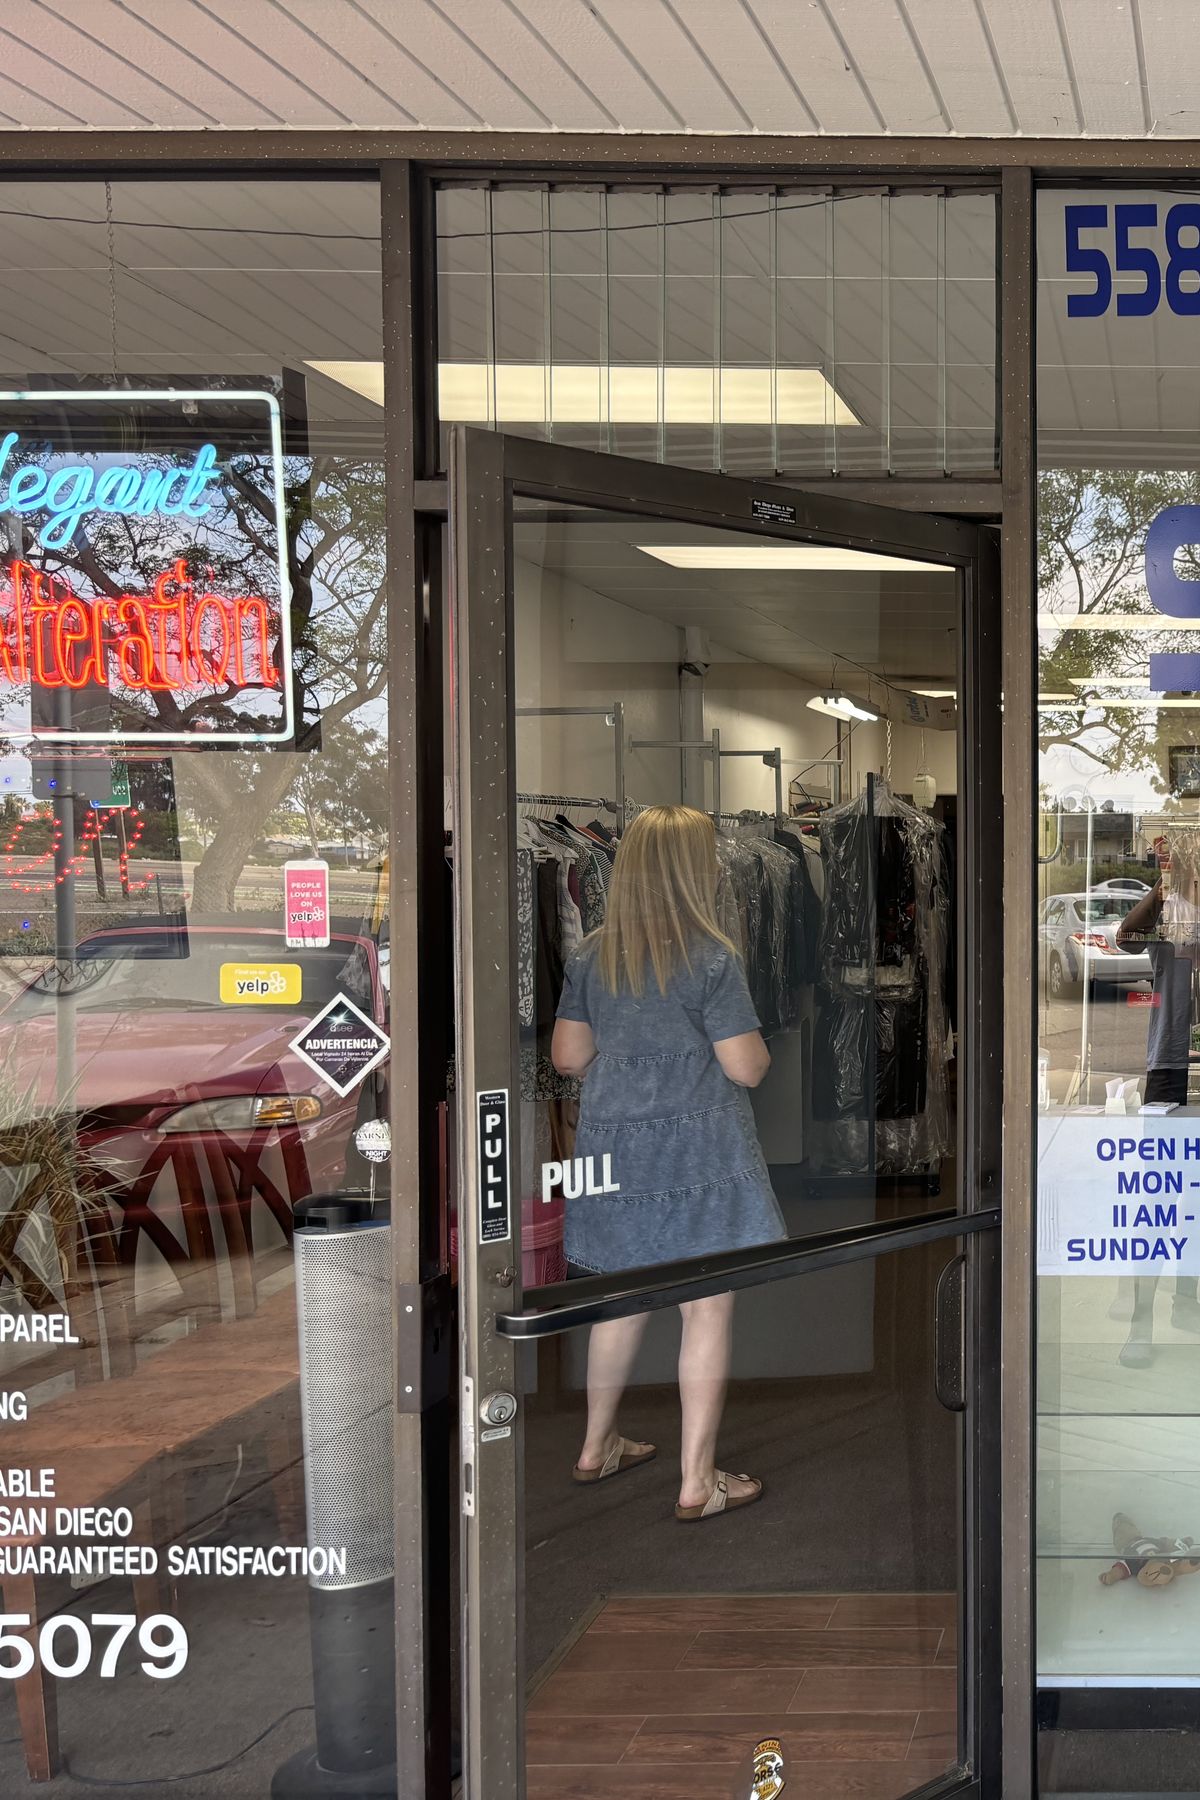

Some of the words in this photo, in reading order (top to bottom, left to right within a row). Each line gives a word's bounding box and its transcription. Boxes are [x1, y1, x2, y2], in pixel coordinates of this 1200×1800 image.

[290, 911, 314, 923] yelp
[237, 978, 269, 994] yelp
[305, 1038, 379, 1050] ADVERTENCIA
[484, 1112, 503, 1210] PULL
[1096, 1138, 1176, 1161] OPEN
[541, 1152, 621, 1204] PULL
[1117, 1171, 1183, 1194] MON
[1067, 1237, 1189, 1262] SUNDAY
[0, 1506, 47, 1537] SAN
[55, 1507, 133, 1537] DIEGO
[168, 1544, 347, 1577] SATISFACTION
[0, 1613, 189, 1680] 5079
